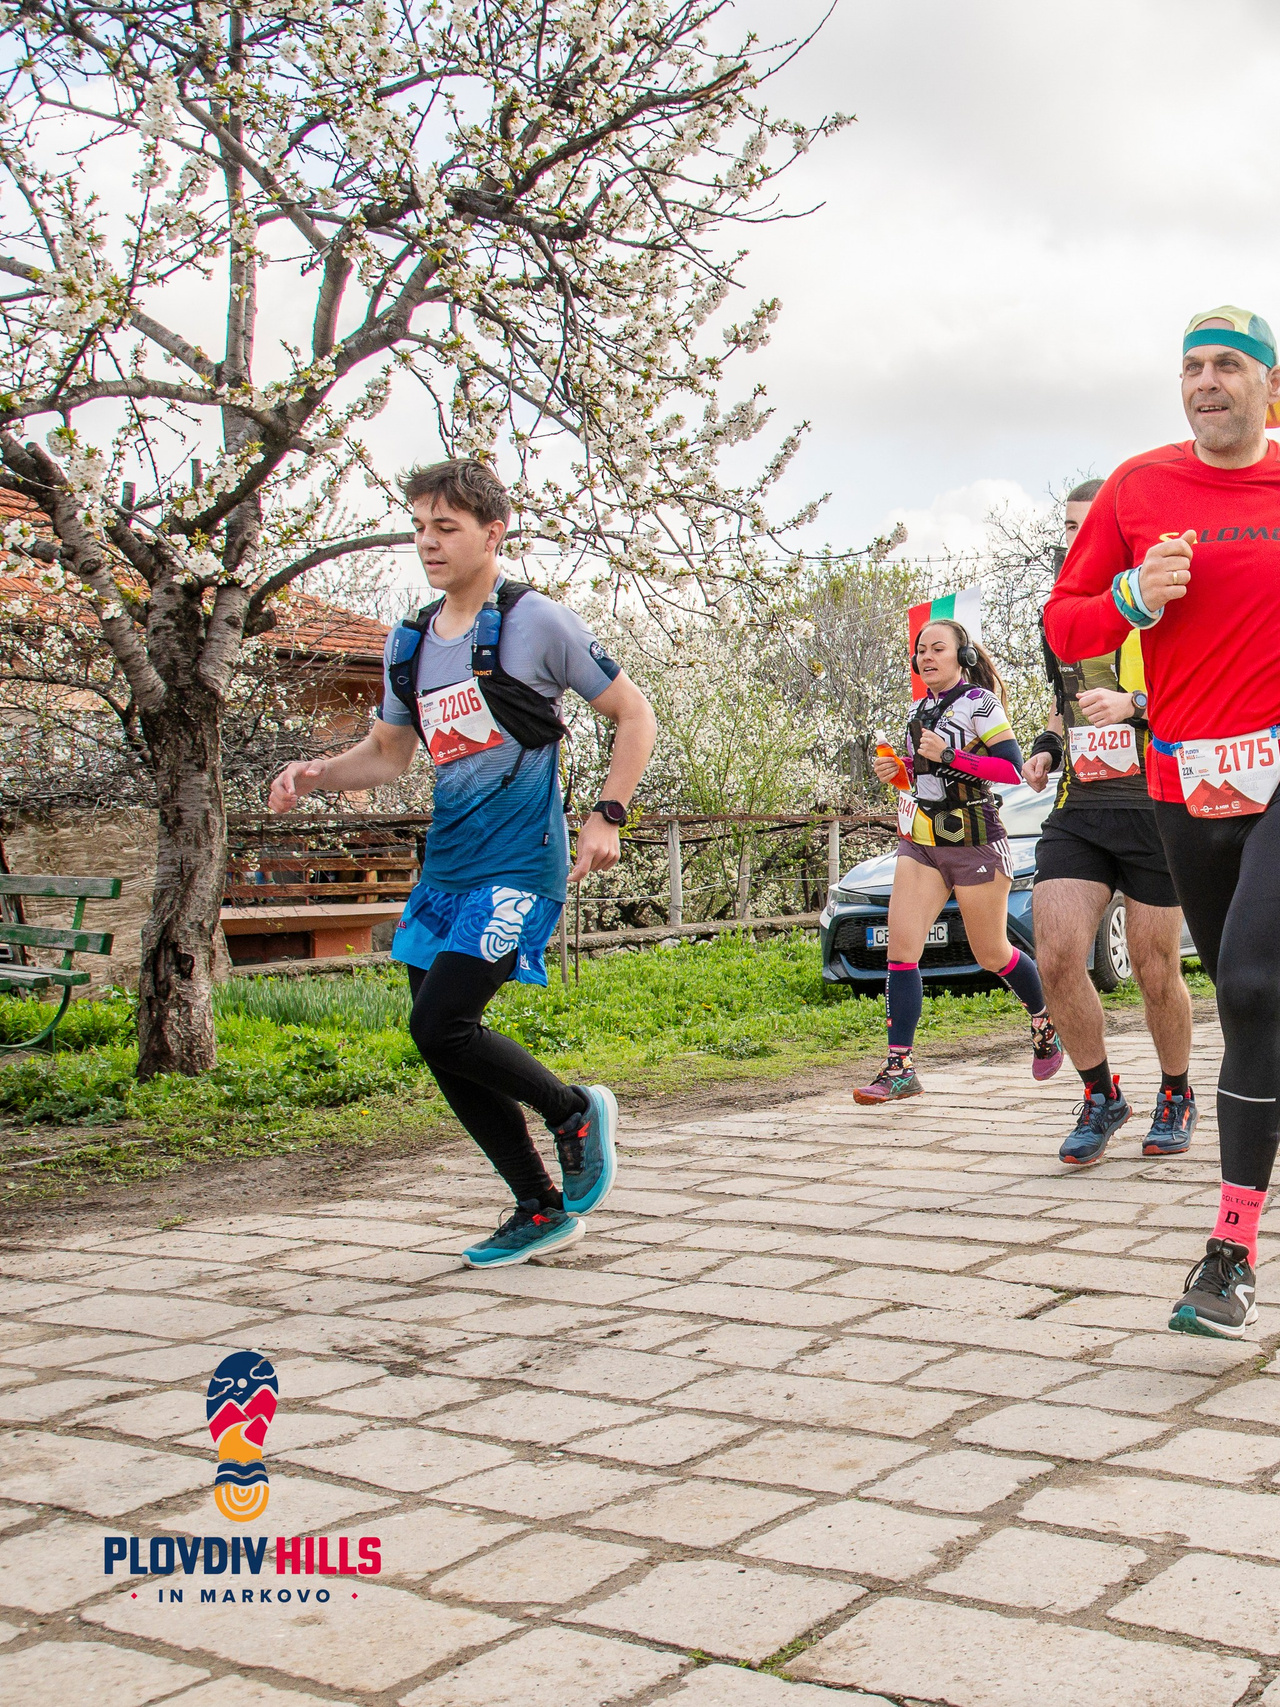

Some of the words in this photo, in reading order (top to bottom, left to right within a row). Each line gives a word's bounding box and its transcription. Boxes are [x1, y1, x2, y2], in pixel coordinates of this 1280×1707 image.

[438, 687, 482, 724] 2206
[1087, 729, 1131, 752] 2420
[1214, 737, 1275, 775] 2175
[1182, 766, 1194, 776] 22K
[1225, 1211, 1240, 1226] D
